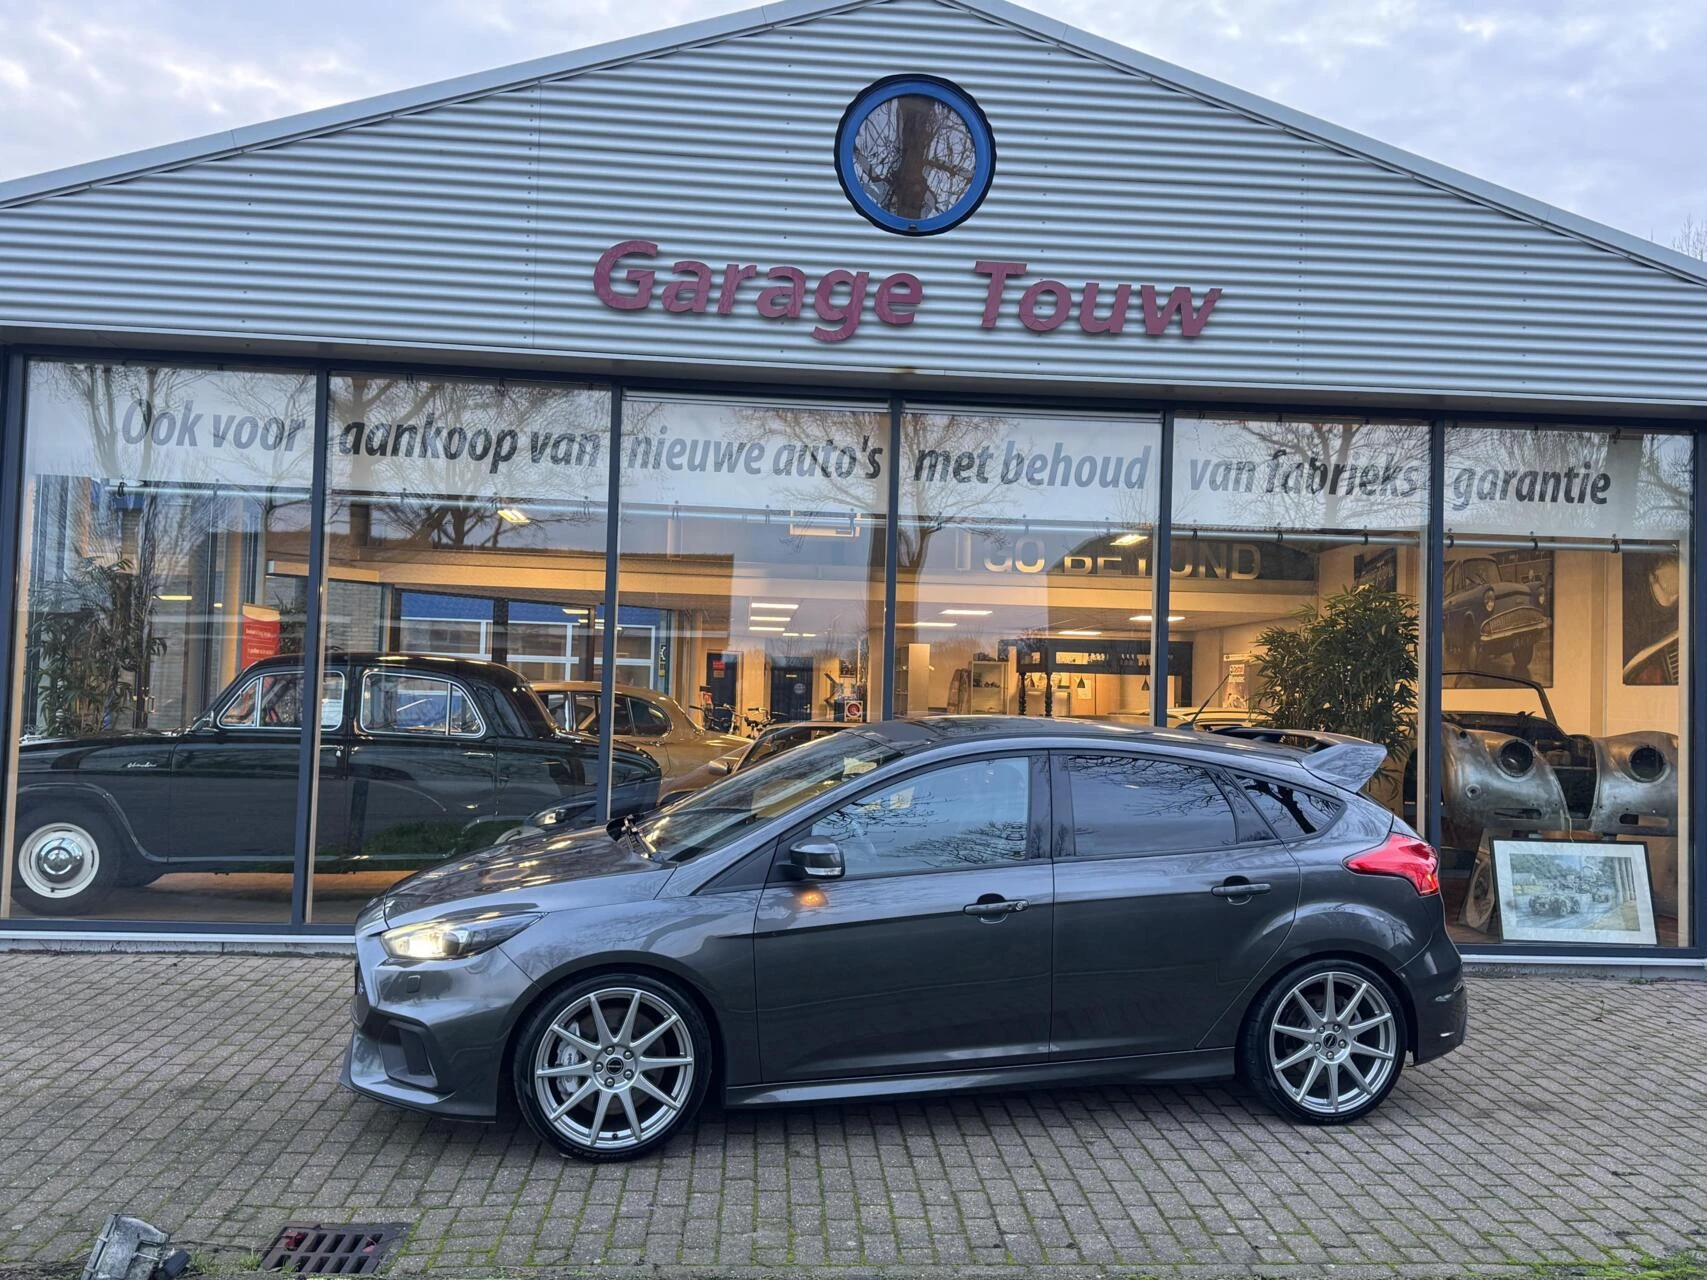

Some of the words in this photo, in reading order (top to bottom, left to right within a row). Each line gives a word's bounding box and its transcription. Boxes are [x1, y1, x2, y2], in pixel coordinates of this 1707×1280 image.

[593, 239, 924, 342] Garage
[974, 260, 1223, 337] Touw
[121, 399, 204, 447] Ook
[212, 413, 307, 452] voor
[338, 413, 519, 474] aankoop
[529, 431, 602, 467] van
[627, 425, 766, 475] nieuwe
[772, 435, 884, 480] auto's
[913, 445, 994, 484] met
[1001, 440, 1152, 489] behoud
[1189, 459, 1257, 493] van
[1264, 449, 1422, 498] fabrieks
[1452, 461, 1612, 511] garantie
[983, 536, 1046, 574] GO
